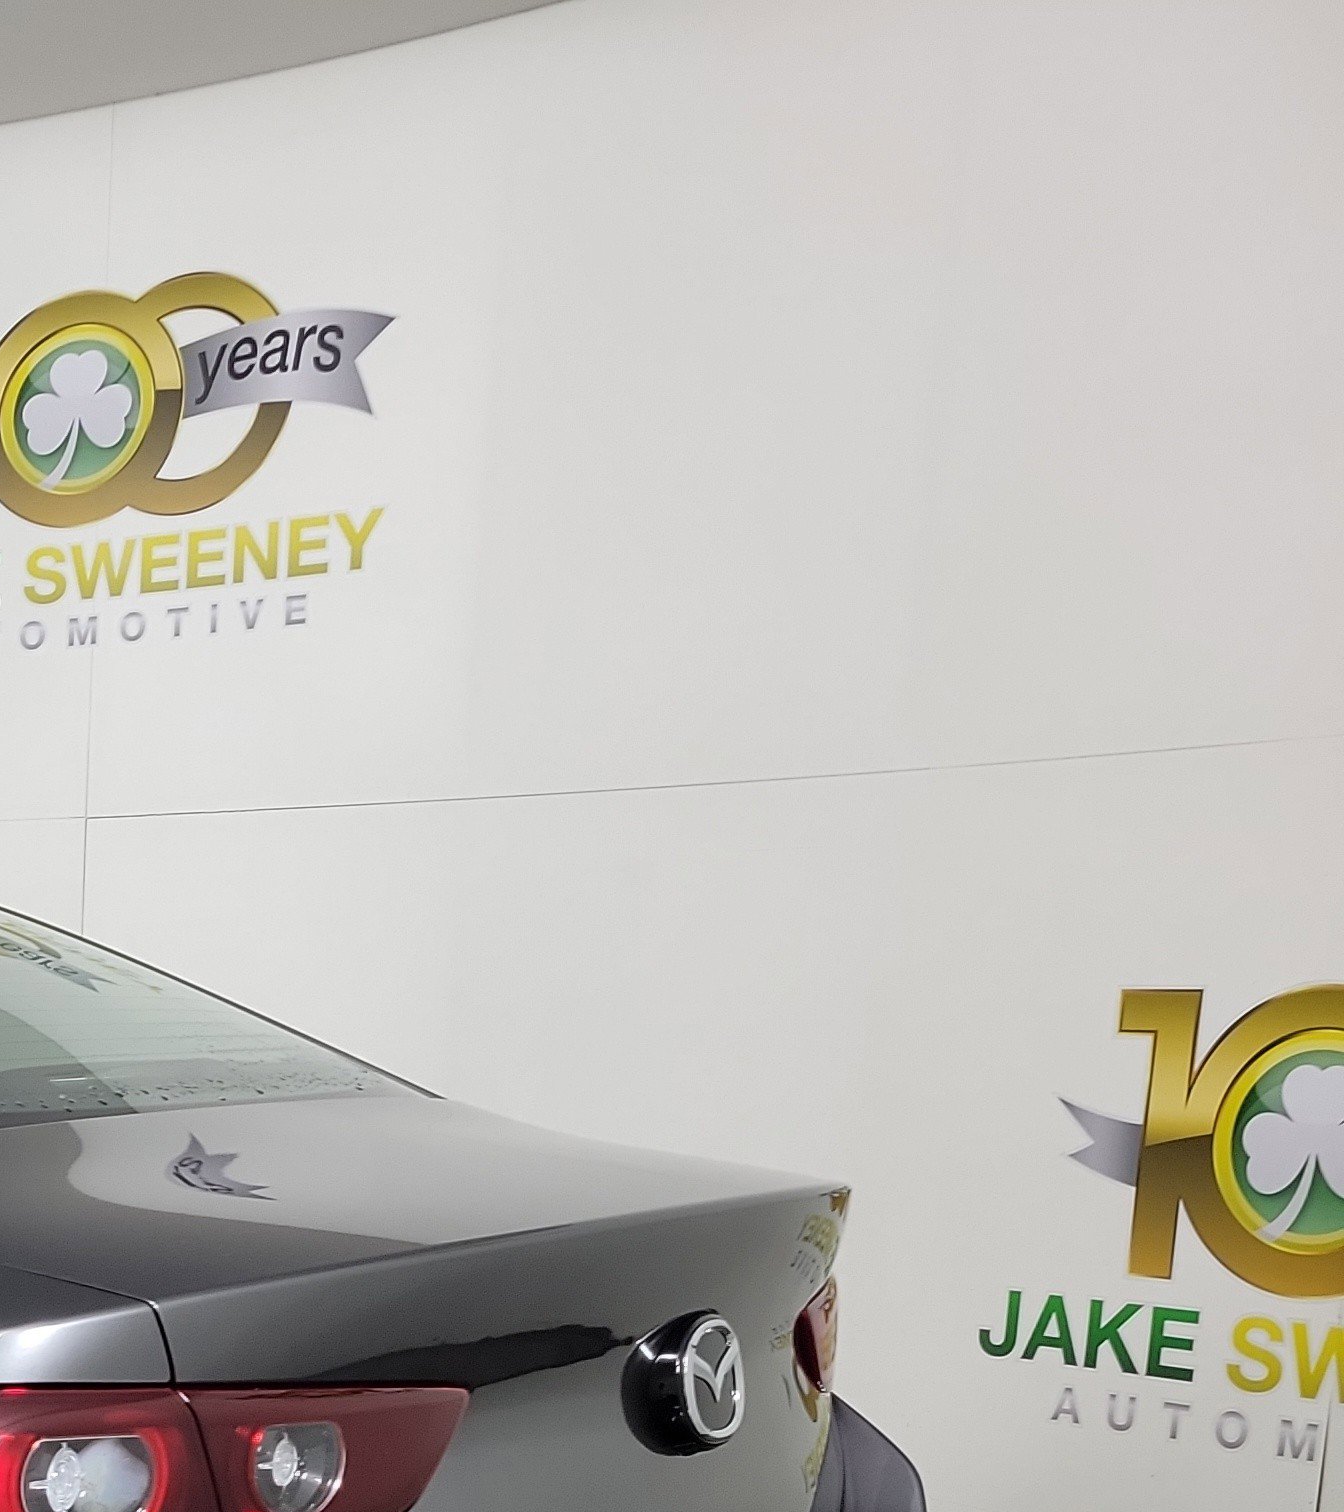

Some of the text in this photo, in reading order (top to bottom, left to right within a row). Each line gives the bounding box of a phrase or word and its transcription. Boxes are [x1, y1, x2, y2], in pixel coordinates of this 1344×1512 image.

[194, 323, 344, 406] years
[23, 505, 386, 606] SWEENEY
[1117, 982, 1344, 1300] 10
[978, 1290, 1344, 1405] JAKE SW
[1050, 1386, 1324, 1463] AUTOM
